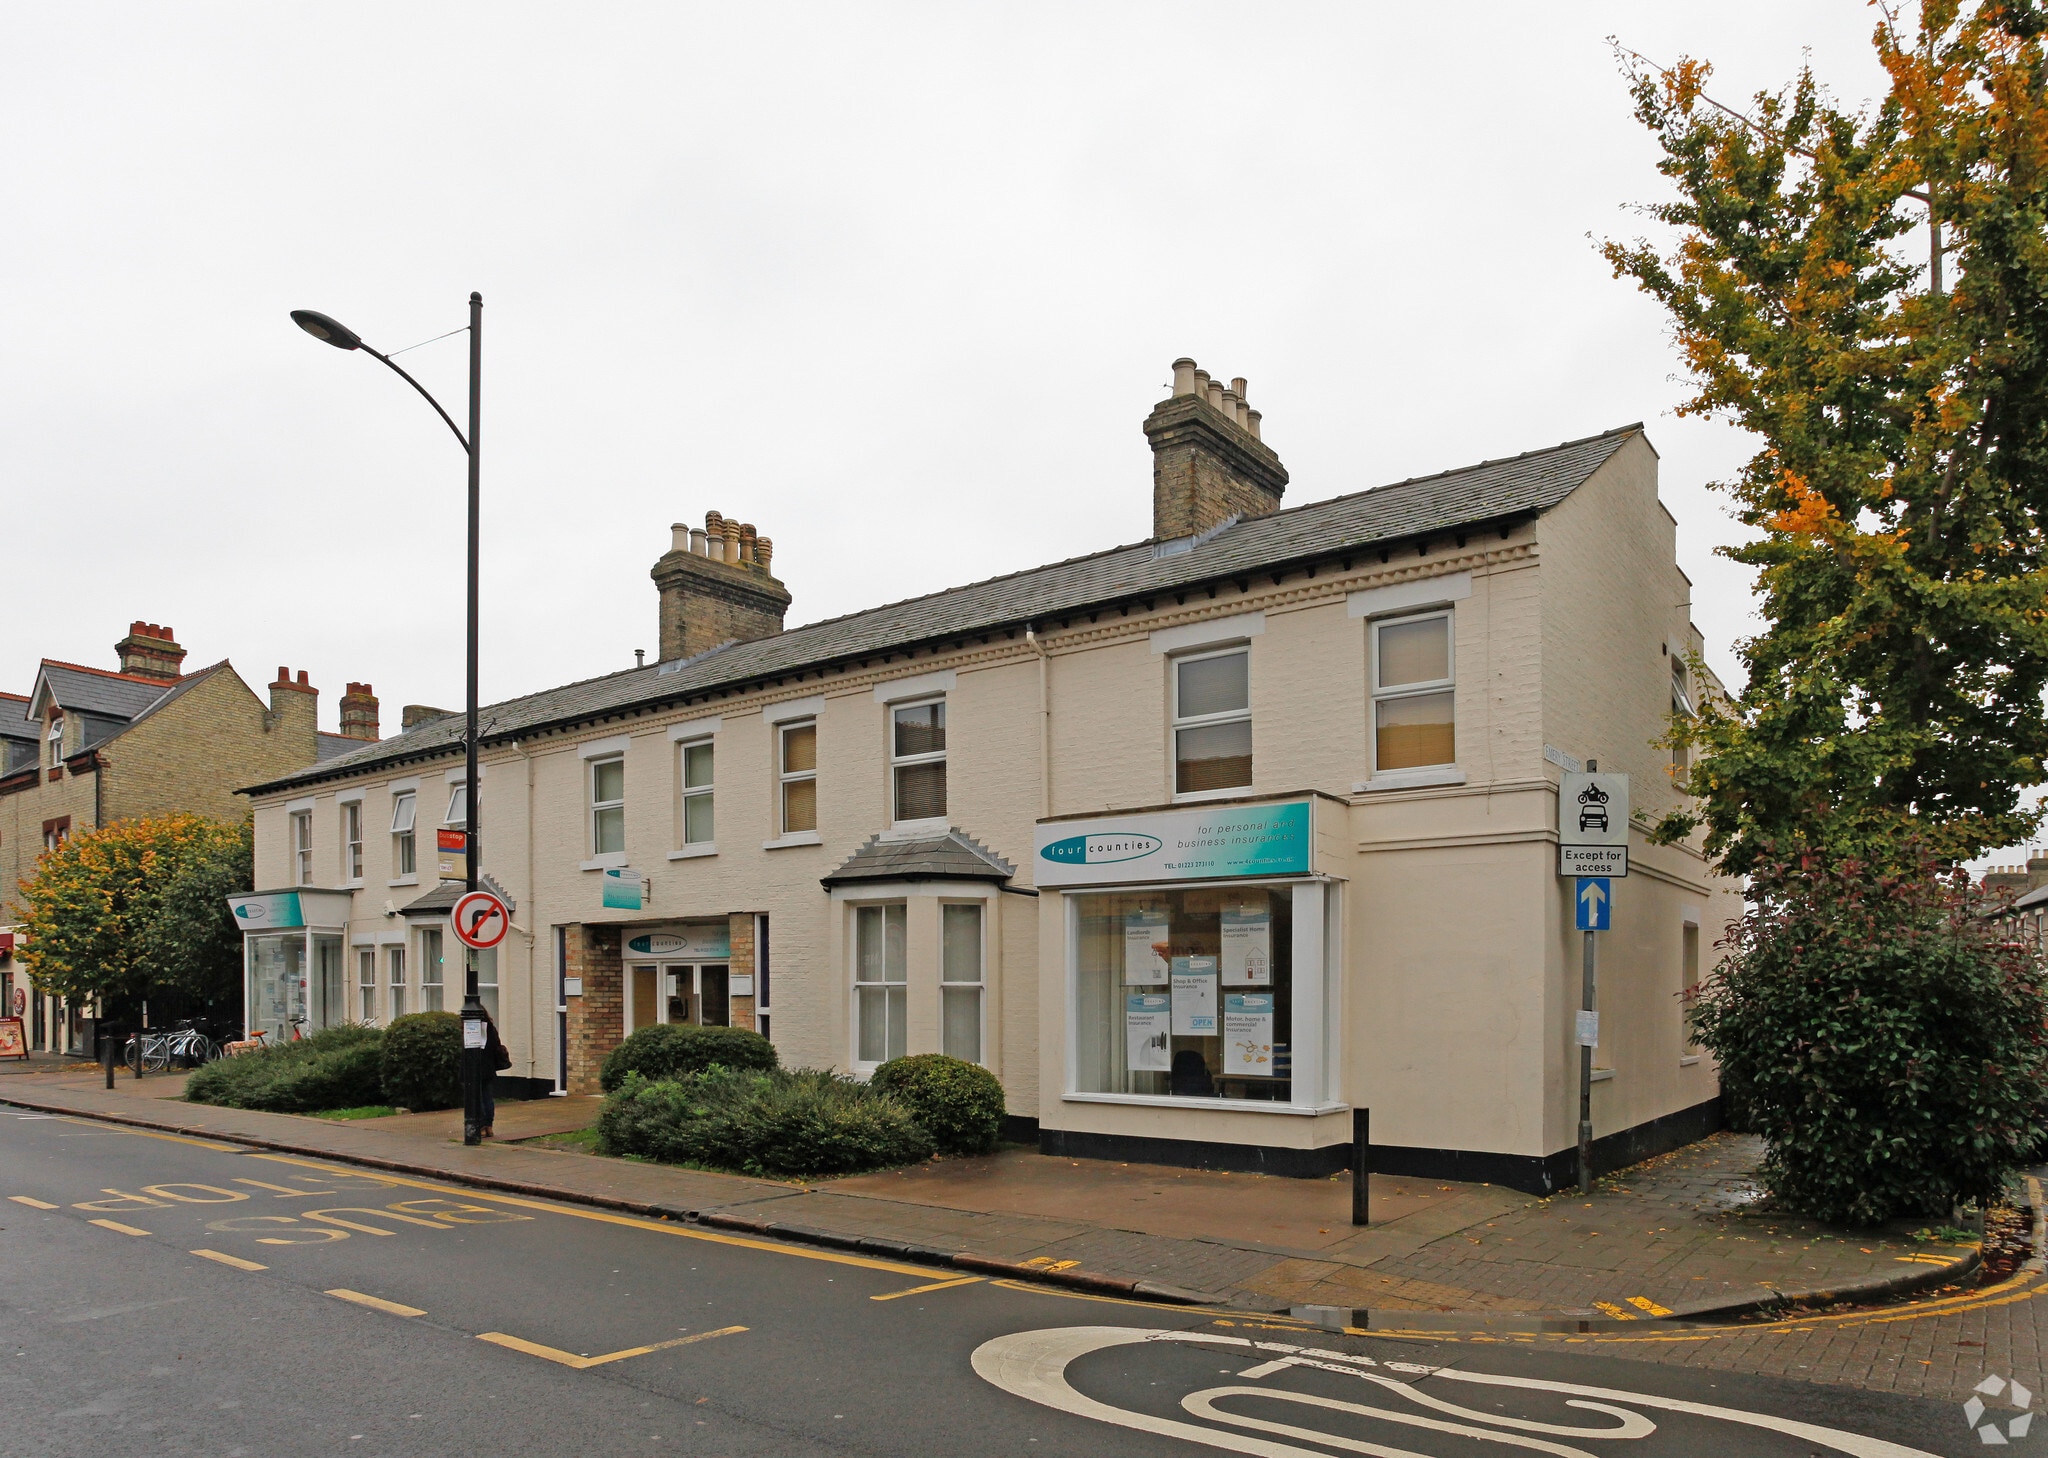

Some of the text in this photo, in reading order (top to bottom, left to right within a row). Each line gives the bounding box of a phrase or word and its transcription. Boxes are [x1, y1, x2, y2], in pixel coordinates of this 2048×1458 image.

[1562, 753, 1579, 771] STREET
[1198, 819, 1295, 834] for personal and
[1051, 840, 1151, 856] four counties
[1177, 833, 1295, 849] business insurances
[1565, 850, 1622, 862] Except for
[1164, 862, 1177, 870] TEL:
[1177, 861, 1195, 869] 01223
[1575, 864, 1613, 872] access
[1192, 1018, 1214, 1027] OPEN
[204, 1198, 536, 1245] BUS
